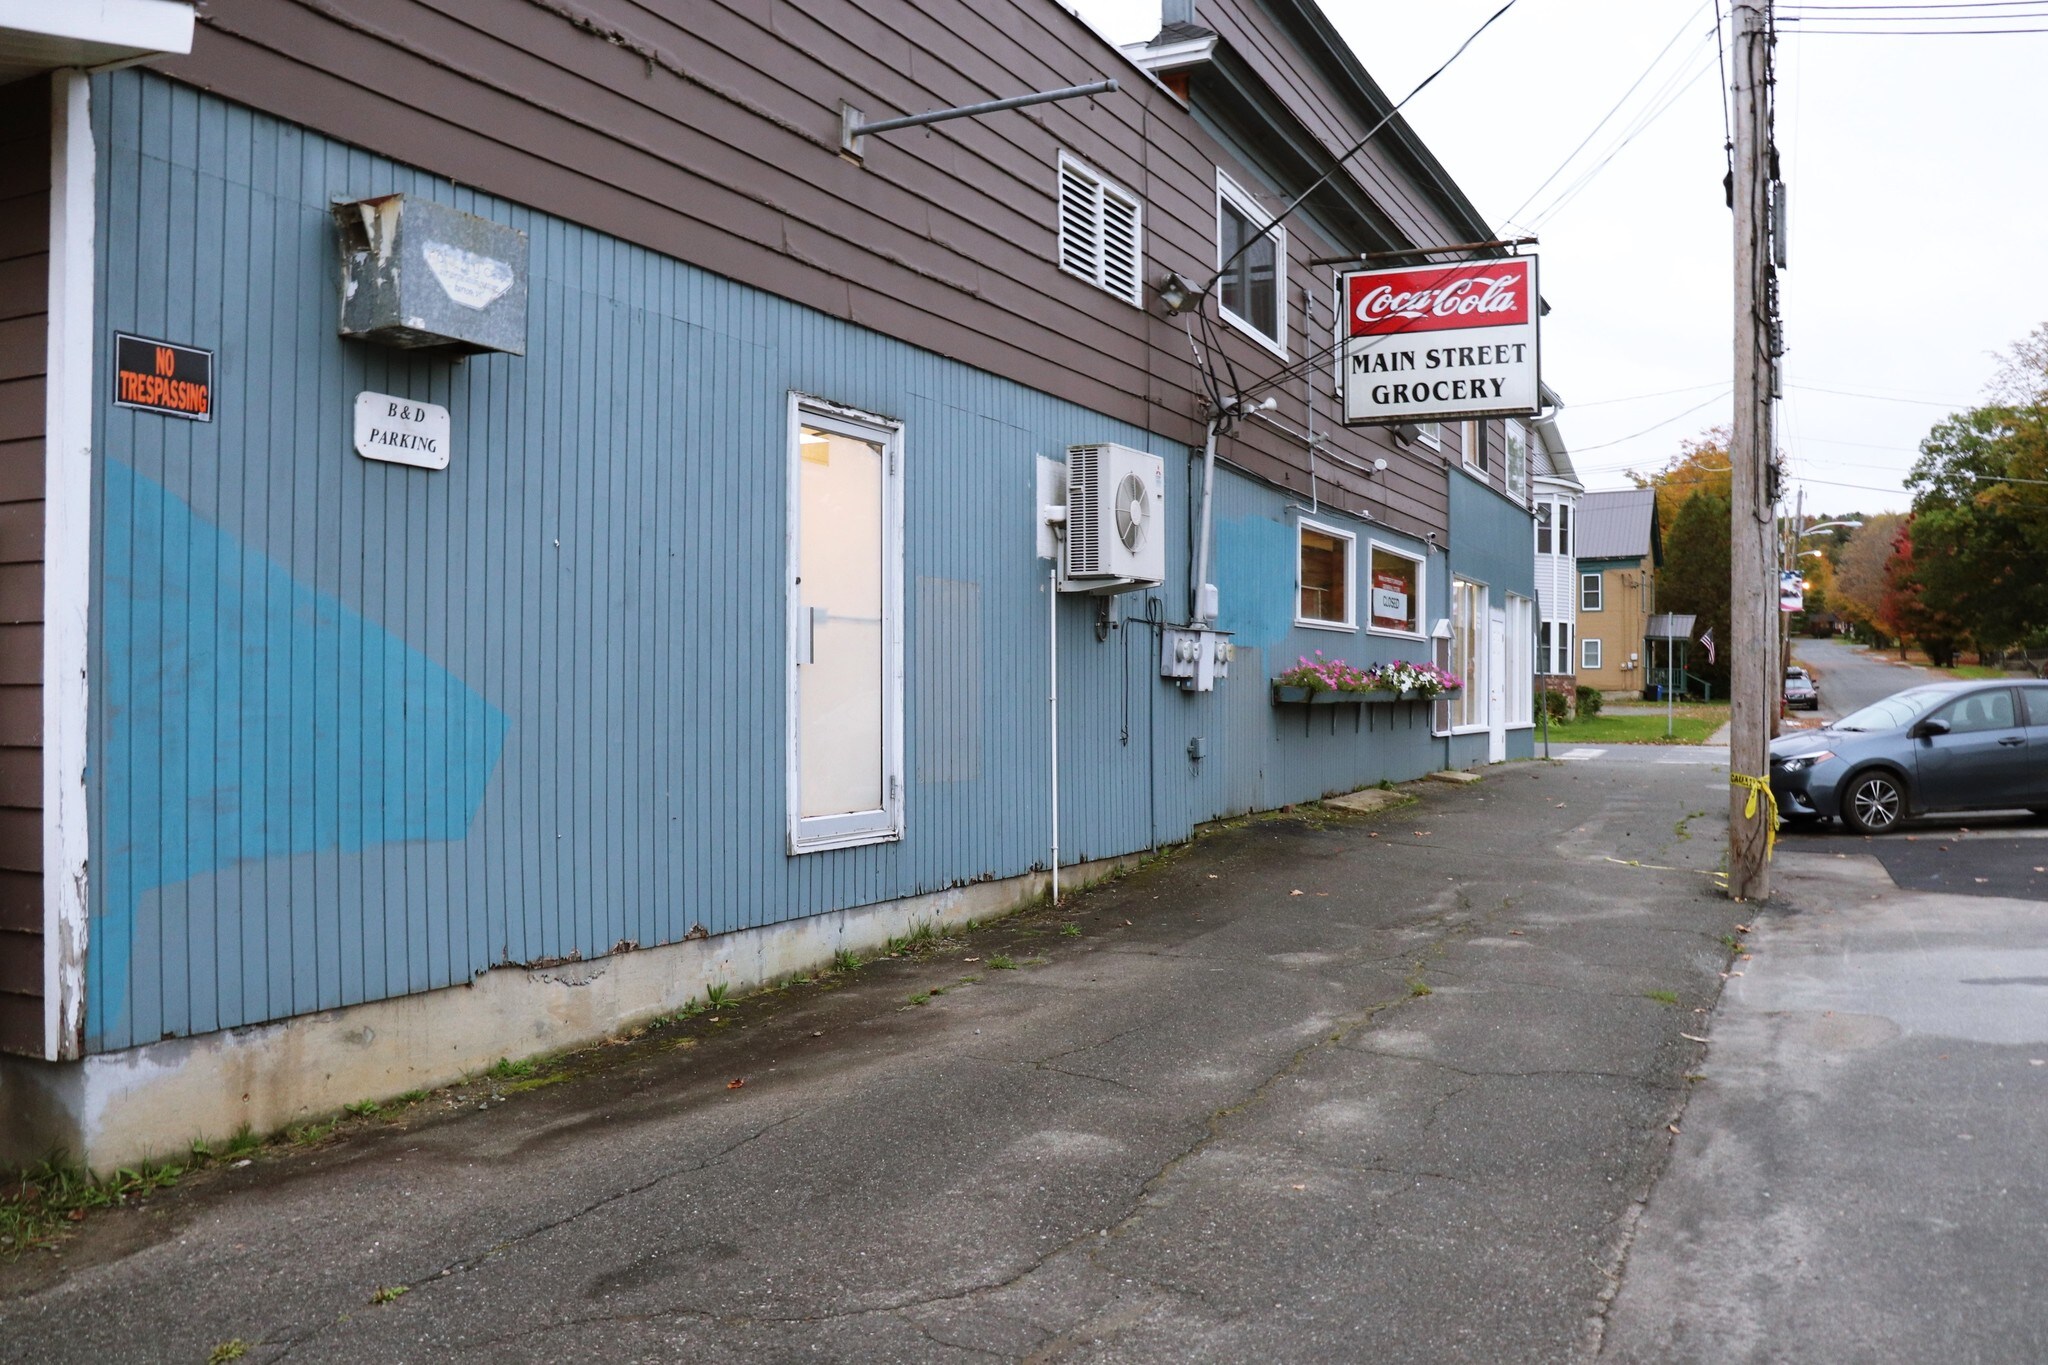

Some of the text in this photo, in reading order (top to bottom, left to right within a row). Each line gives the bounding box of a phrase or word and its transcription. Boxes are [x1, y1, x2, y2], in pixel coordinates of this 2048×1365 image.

[1355, 274, 1521, 323] Coca-Cola
[155, 346, 175, 377] NO
[1352, 343, 1527, 374] MAIN STREET
[120, 370, 207, 413] TRESPASSING
[1371, 377, 1506, 405] GROCERY
[388, 402, 425, 422] B & D
[369, 428, 437, 453] PARKING
[1383, 595, 1400, 609] CLOSED
